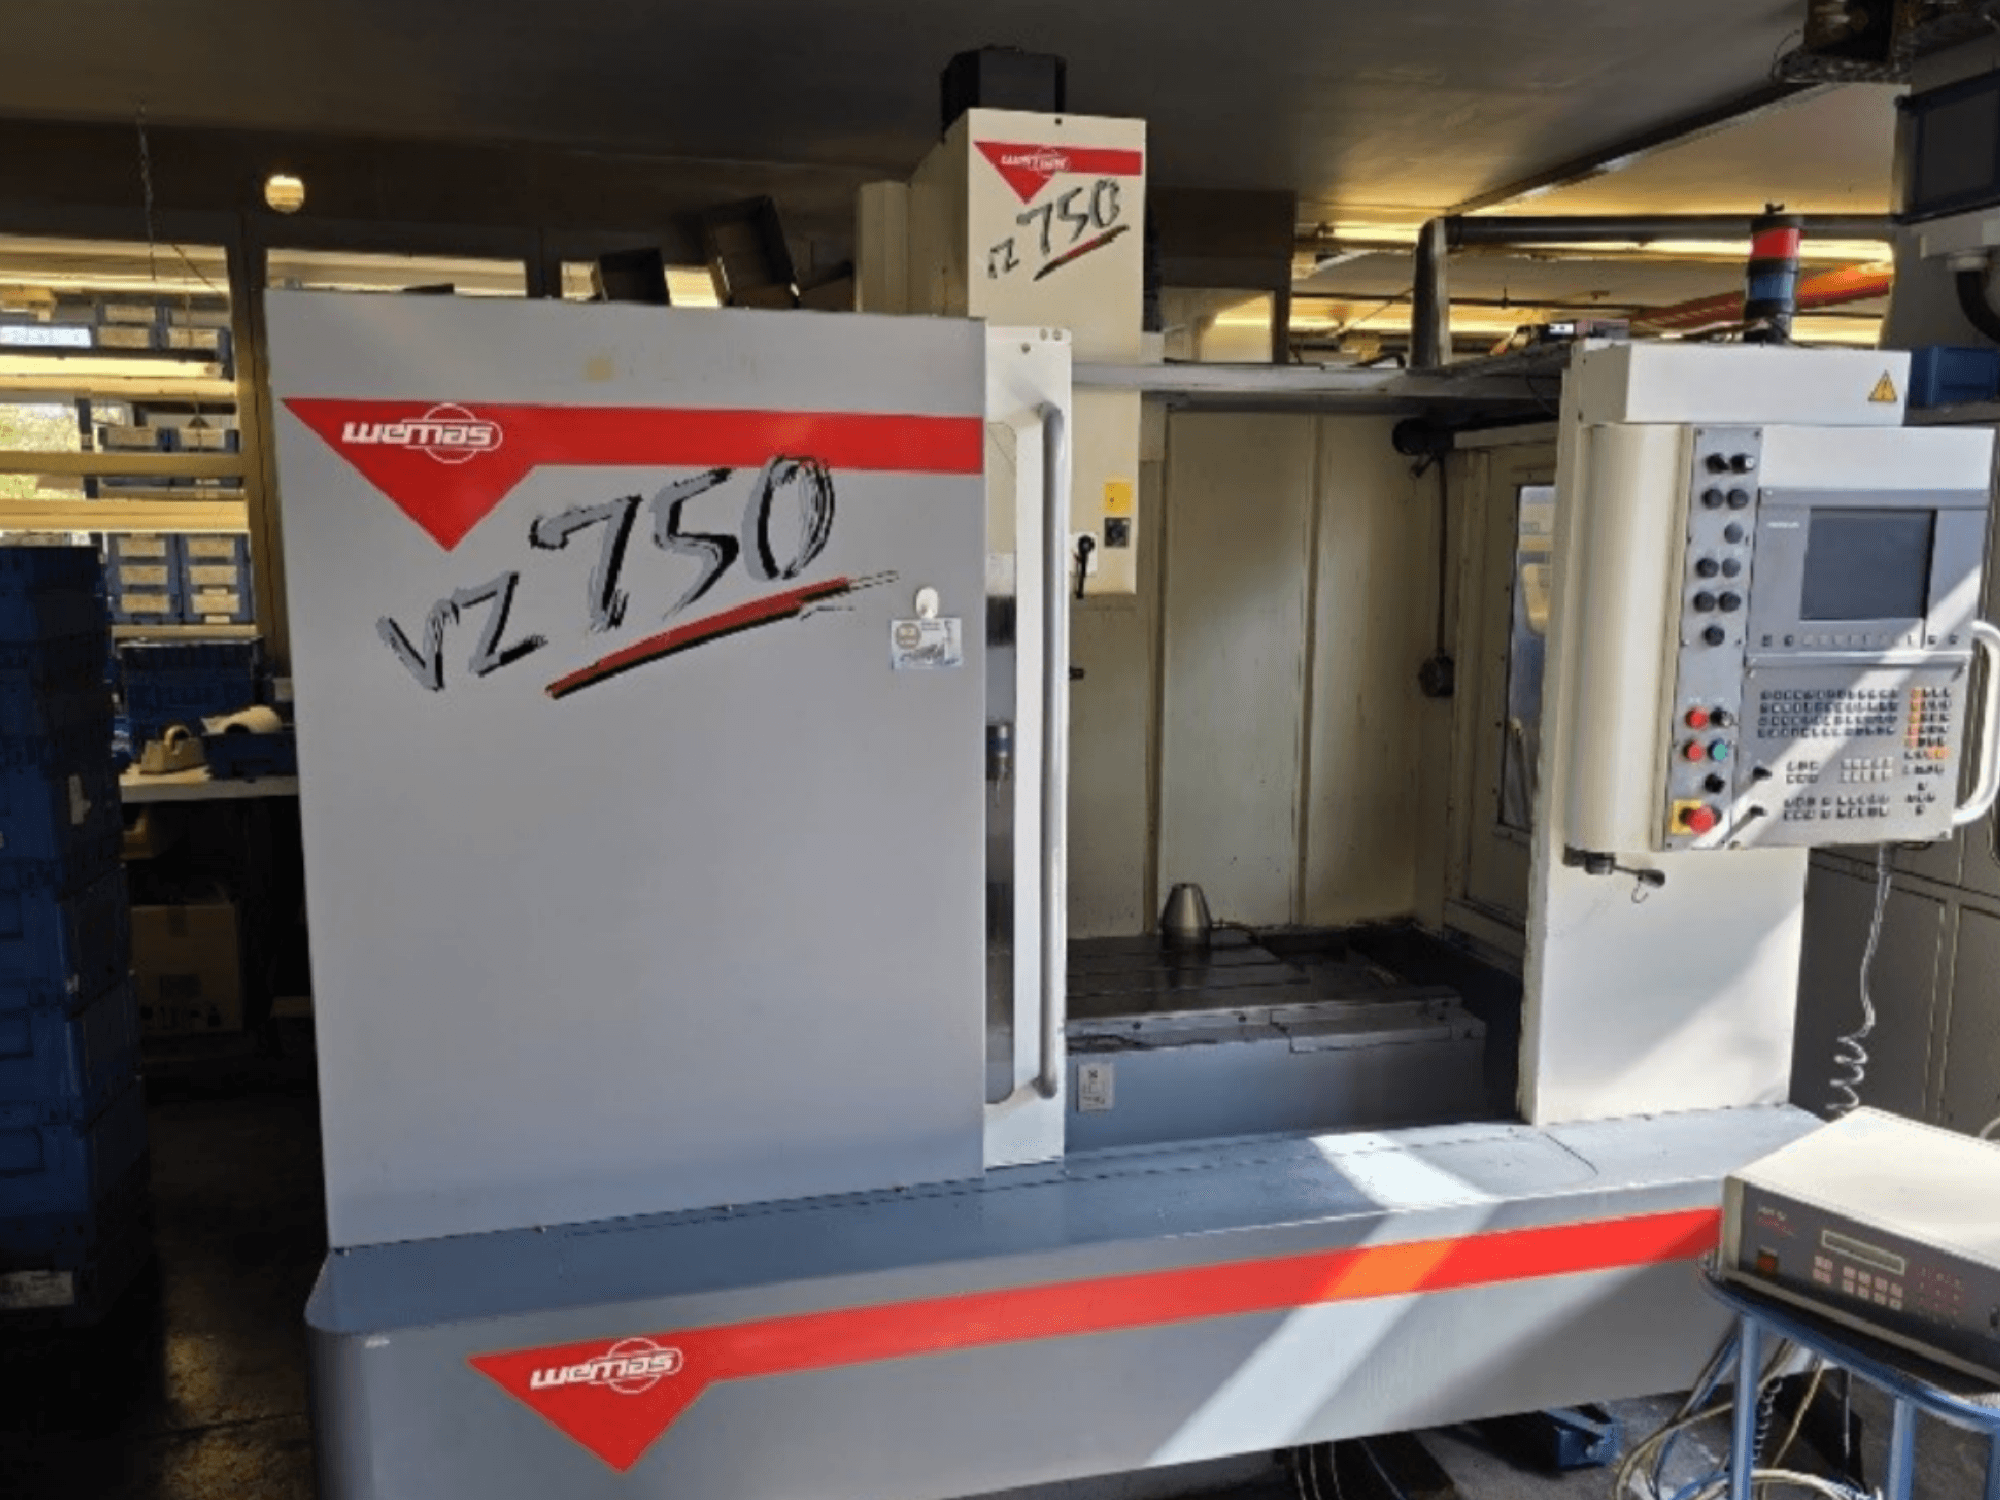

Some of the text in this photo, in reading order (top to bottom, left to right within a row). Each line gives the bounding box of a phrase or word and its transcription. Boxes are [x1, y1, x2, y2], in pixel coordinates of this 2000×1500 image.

[1016, 177, 1121, 256] 750
[341, 420, 494, 446] wemas
[376, 454, 836, 692] VZ 750
[530, 1351, 676, 1390] wemas
